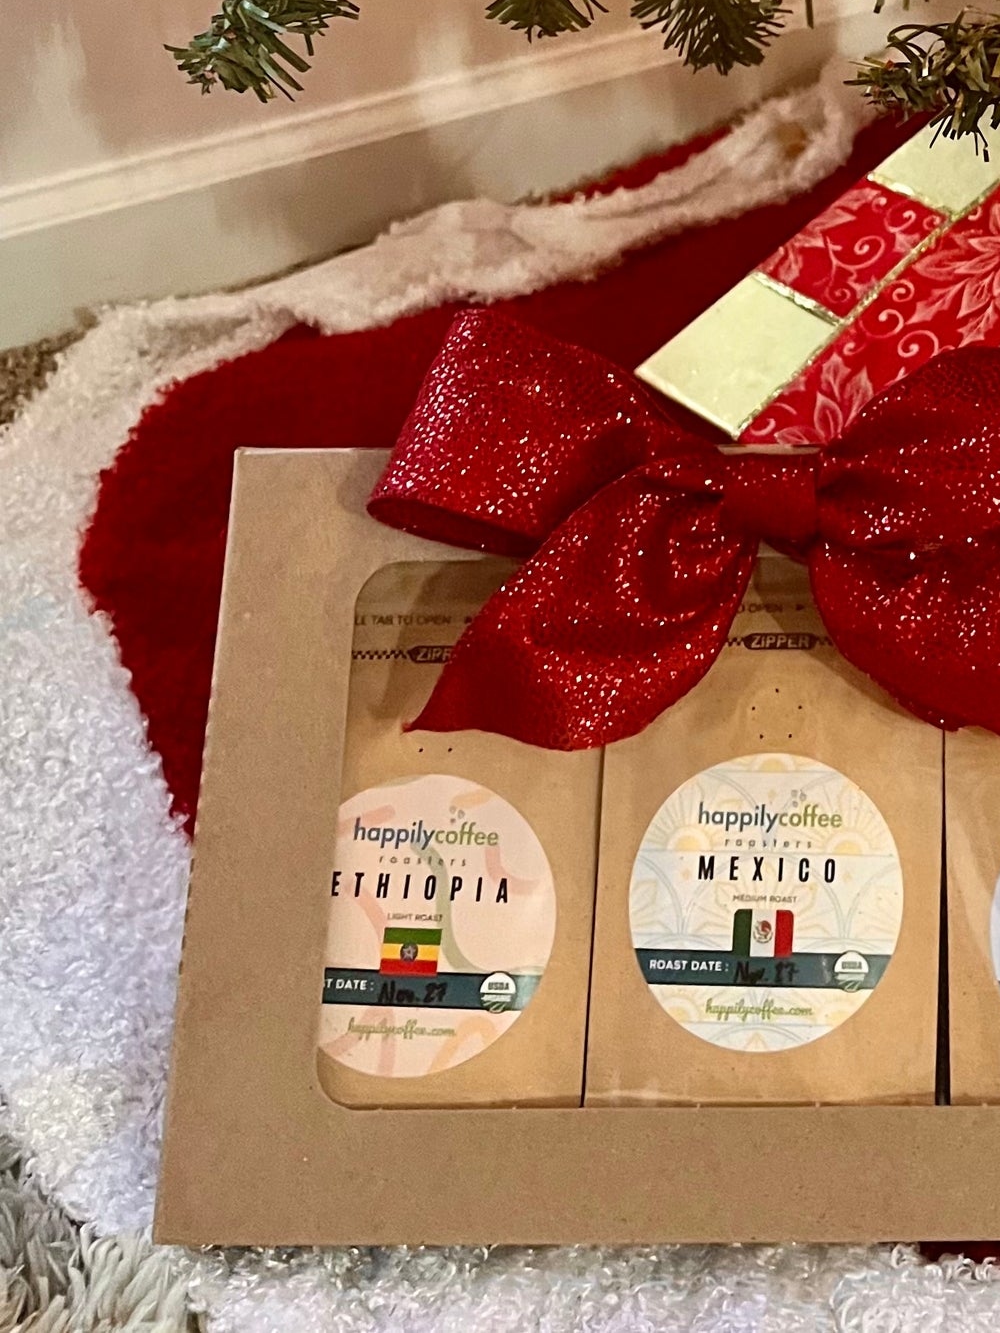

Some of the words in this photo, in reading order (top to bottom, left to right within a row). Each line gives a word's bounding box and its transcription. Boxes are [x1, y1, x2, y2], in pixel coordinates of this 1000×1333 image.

[750, 635, 811, 649] ZIPPER
[698, 801, 843, 834] happilycoffee
[353, 817, 500, 851] happilycoffee
[724, 838, 812, 849] roasters
[379, 855, 467, 867] roasters
[698, 855, 836, 883] MEXICO
[331, 871, 508, 904] ETHIOPIA
[732, 894, 767, 902] MEDIUM
[769, 895, 798, 903] ROAST
[387, 913, 413, 921] LIGHT
[414, 914, 443, 922] ROAST
[649, 959, 687, 970] ROAST
